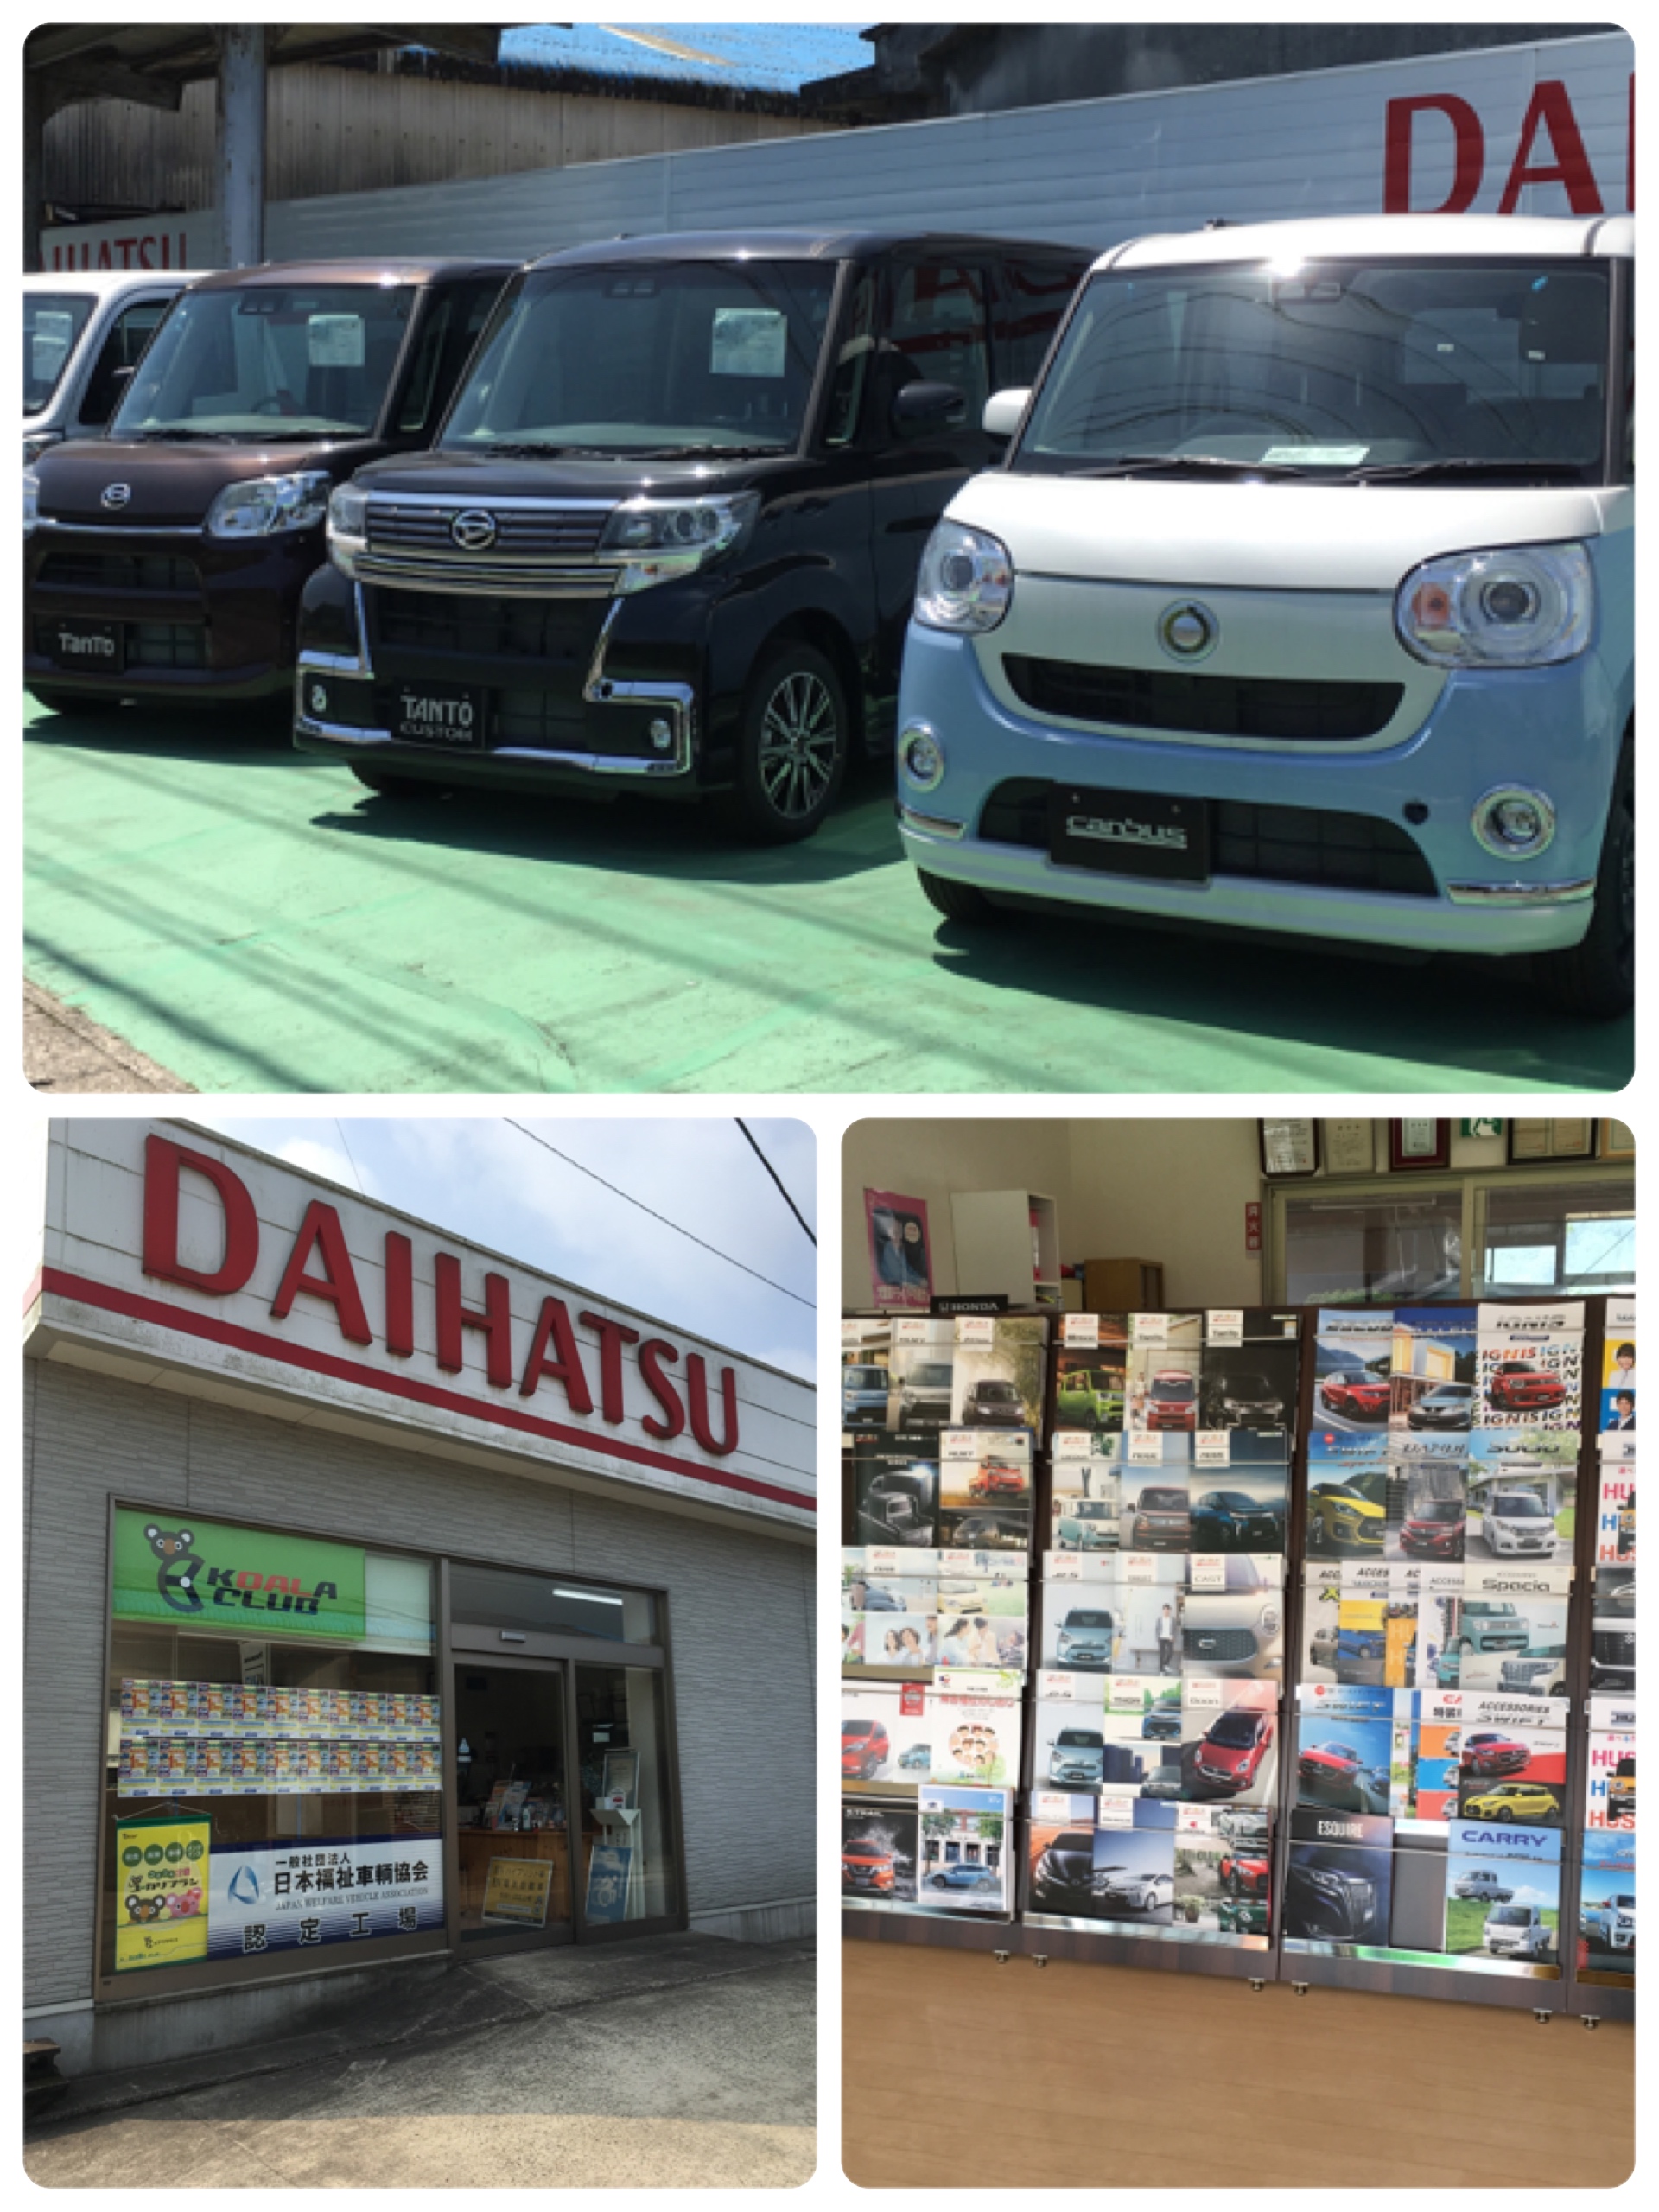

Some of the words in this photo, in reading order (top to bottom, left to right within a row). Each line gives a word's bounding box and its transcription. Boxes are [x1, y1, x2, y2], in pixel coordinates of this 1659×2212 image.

[1384, 72, 1635, 215] DA
[400, 695, 473, 727] TANTO
[142, 1132, 741, 1456] DAIHATSU
[952, 1302, 999, 1312] HONDA
[1482, 1346, 1536, 1362] IGNIS
[207, 1567, 338, 1600] KOALA
[1482, 1578, 1550, 1592] Spacia
[213, 1587, 319, 1616] CLUB
[1478, 1701, 1550, 1714] ACCESSORIES
[1318, 1820, 1363, 1838] ESQUIRE
[1461, 1829, 1548, 1847] CARRY
[276, 1851, 350, 1869] 一般社団法人
[276, 1900, 302, 1911] JAPAN
[305, 1895, 344, 1908] WELFARE
[346, 1891, 378, 1904] VEHICLE
[382, 1887, 429, 1900] ASSOCIATION
[243, 1906, 418, 1954] 認定工場
